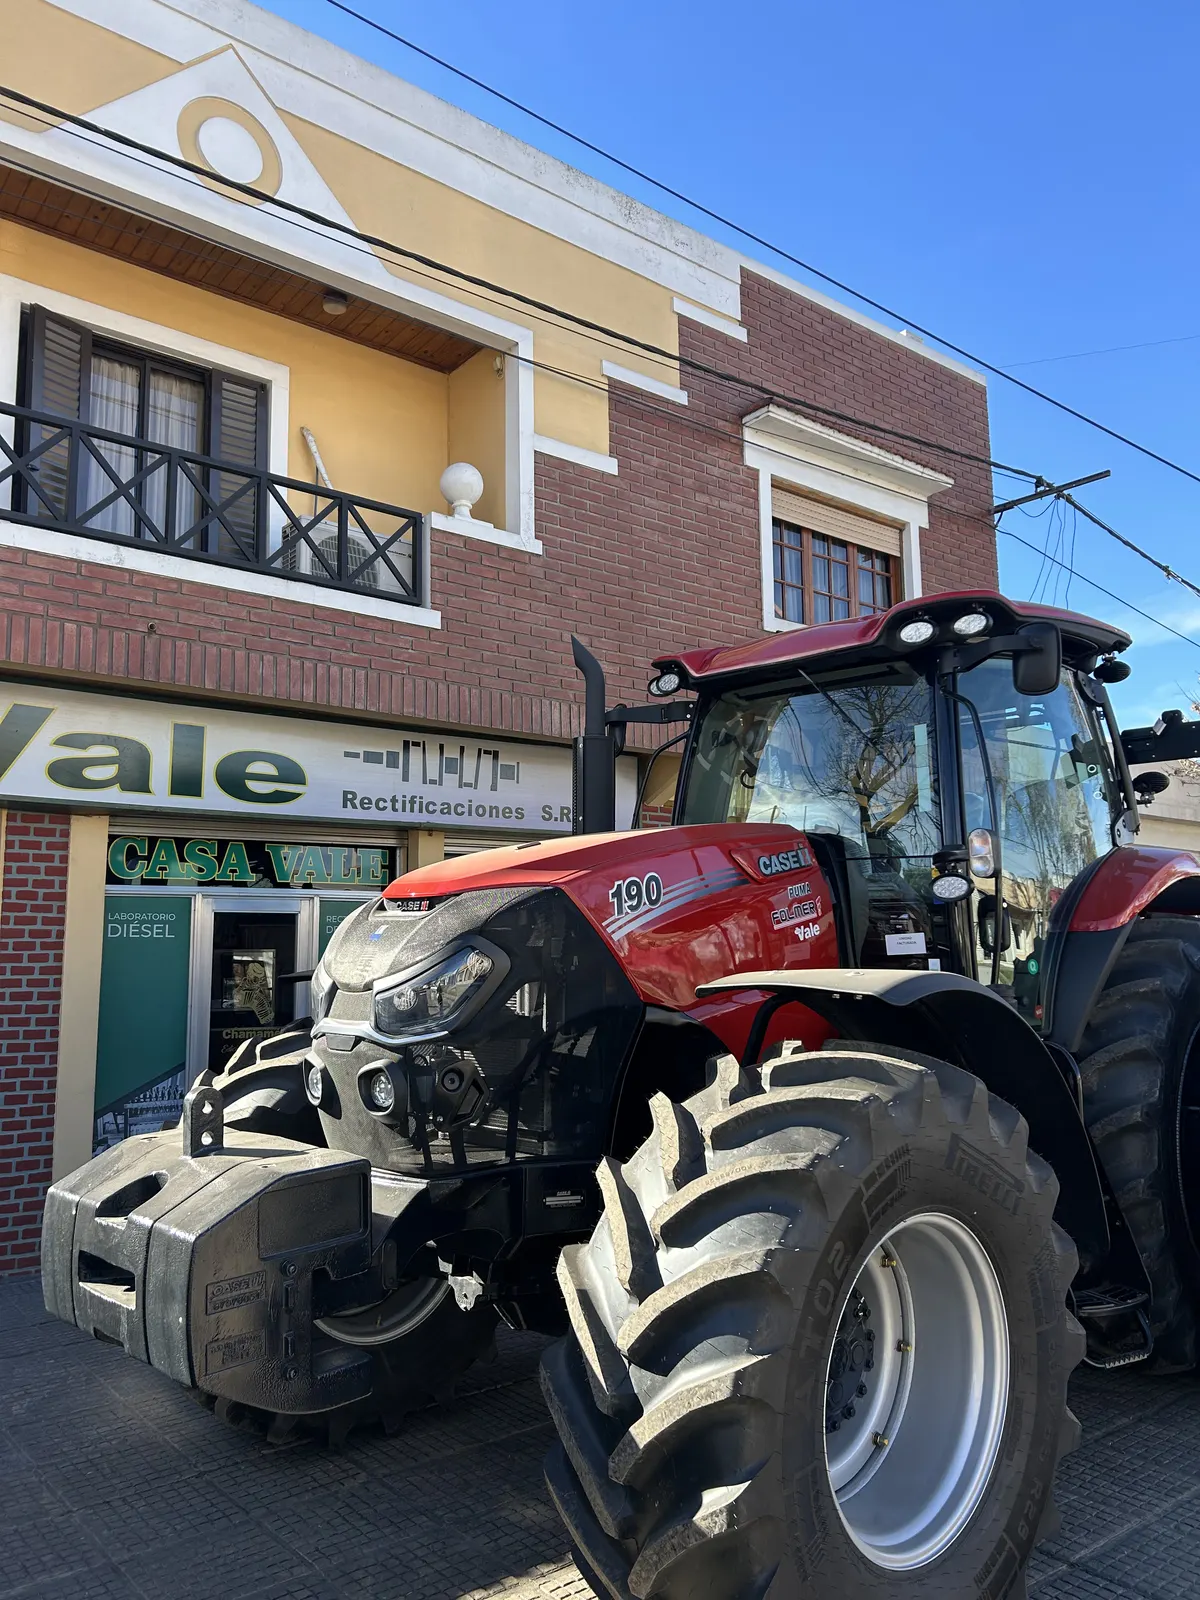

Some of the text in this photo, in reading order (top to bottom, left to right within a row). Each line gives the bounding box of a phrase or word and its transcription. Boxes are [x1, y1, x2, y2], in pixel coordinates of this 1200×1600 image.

[342, 789, 525, 820] Rectificaciones
[108, 836, 389, 886] CASA VALE
[758, 850, 800, 876] CASE
[608, 871, 664, 918] 190
[788, 881, 812, 899] PUMA
[108, 912, 176, 921] LABORATORIO
[396, 901, 420, 911] CASE
[770, 900, 817, 926] FOLMER
[107, 921, 175, 938] DIÉSEL
[795, 922, 820, 941] Vale
[946, 1132, 1024, 1215] PIRELLI
